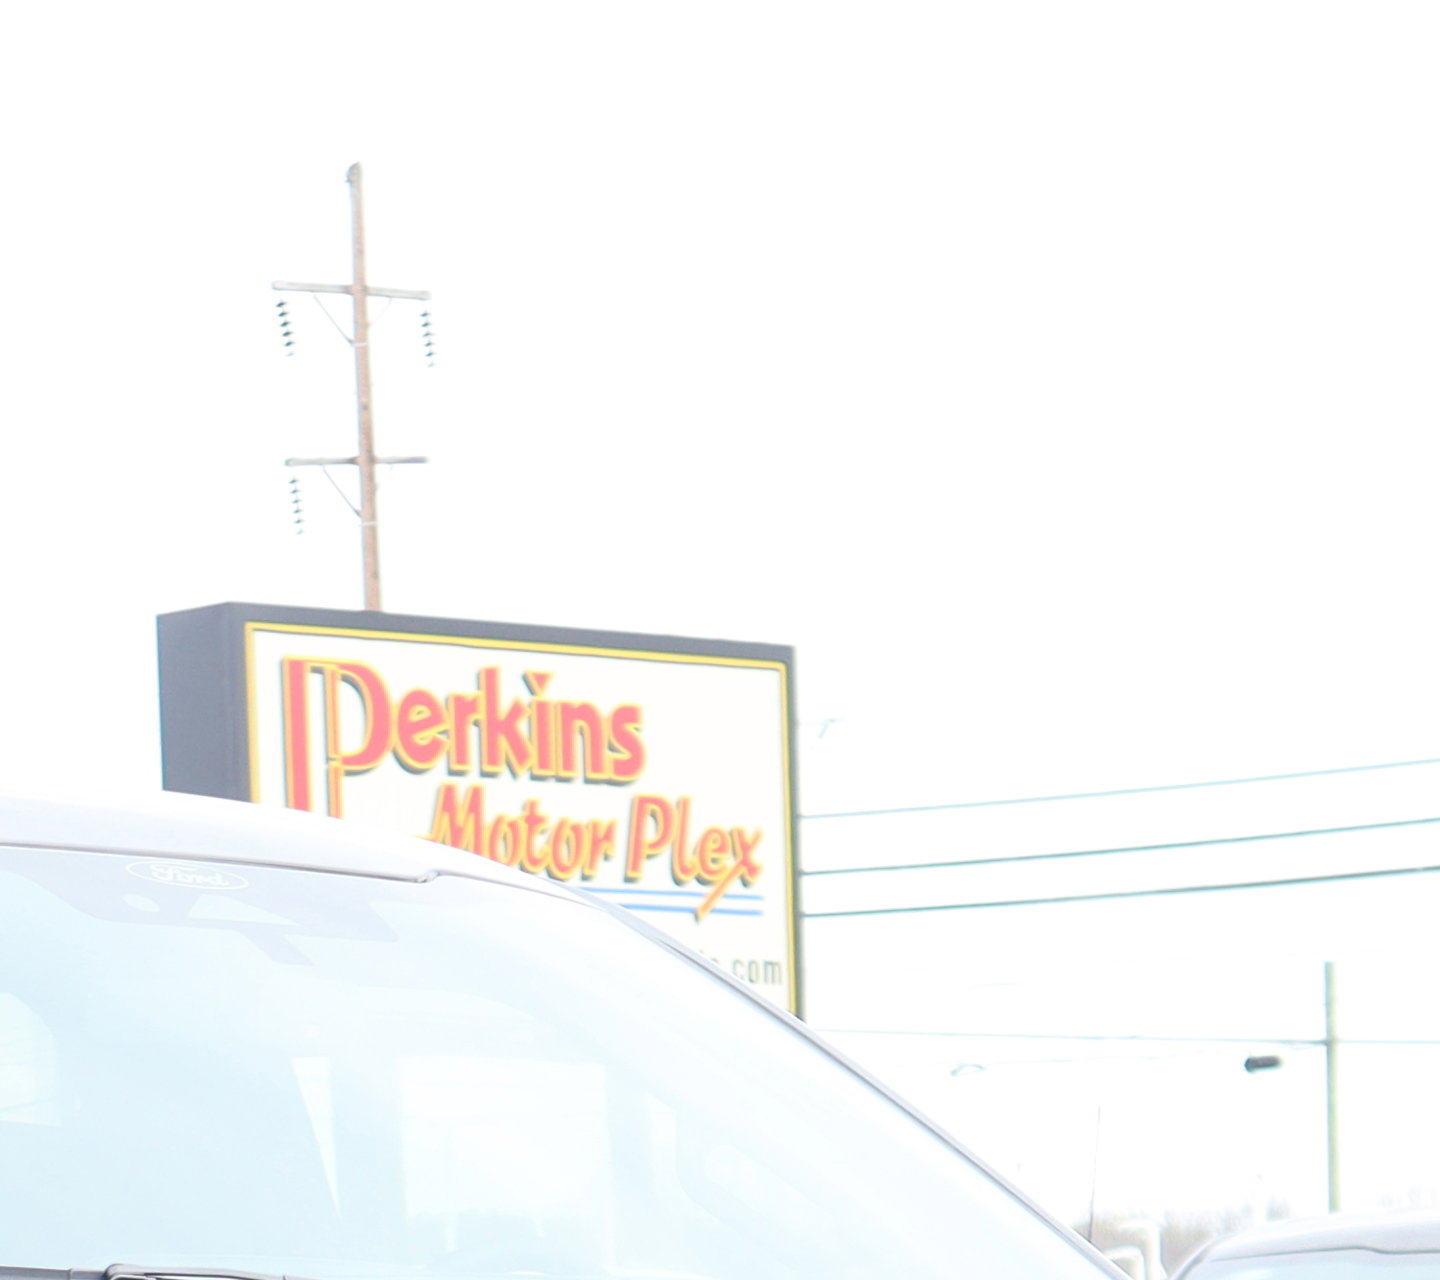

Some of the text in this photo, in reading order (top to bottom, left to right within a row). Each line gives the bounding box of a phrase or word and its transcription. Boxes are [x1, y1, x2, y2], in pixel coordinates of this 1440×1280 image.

[281, 655, 650, 818] Perkins
[428, 783, 764, 922] Motor Plex
